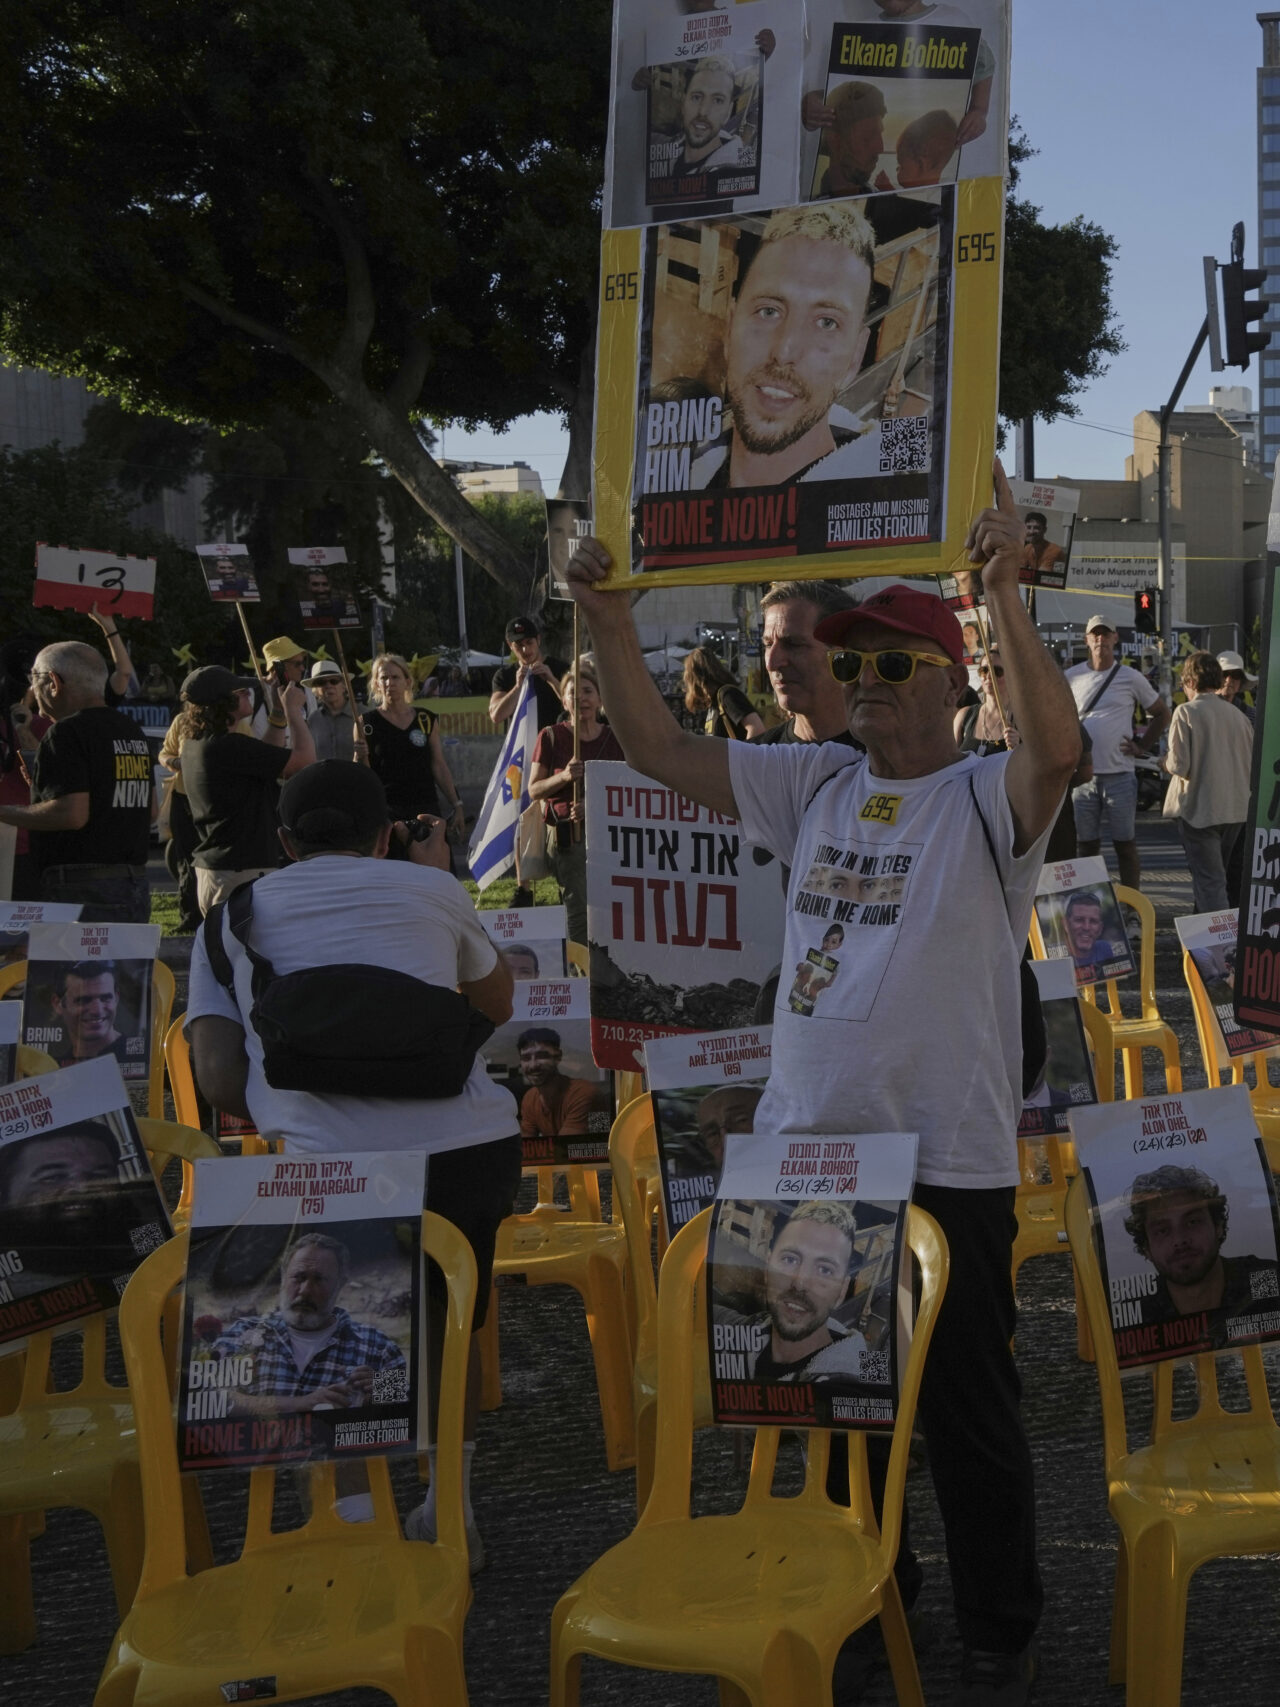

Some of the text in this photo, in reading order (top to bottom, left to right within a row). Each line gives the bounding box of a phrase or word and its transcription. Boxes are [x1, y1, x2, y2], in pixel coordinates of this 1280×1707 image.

[683, 31, 707, 43] ELKANA
[840, 35, 968, 69] Elkana Bohbot
[650, 143, 680, 160] BRING
[650, 161, 667, 178] HIM
[957, 232, 996, 263] 695
[604, 272, 638, 301] 695
[648, 396, 723, 447] BRING
[643, 447, 692, 494] HIM
[643, 486, 798, 547] HOME NOW!
[827, 498, 929, 519] HOSTAGES AND MISSING
[827, 514, 929, 543] FAMILIES FORUM
[1071, 567, 1158, 576] Tel Aviv Museum of
[113, 738, 130, 755] ALL
[112, 780, 150, 808] NOW
[605, 785, 700, 823] שוכחים
[860, 795, 898, 821] 695
[607, 825, 740, 878] את איתי
[814, 844, 912, 876] LOOK IN MY EYES
[611, 875, 743, 952] בעזה
[795, 890, 902, 926] BRING ME HOME
[508, 920, 524, 930] CHEN
[80, 937, 98, 946] DROR
[549, 984, 571, 995] אריאל
[527, 995, 572, 1007] ARIEL CUNIO
[529, 1006, 551, 1017] (27)
[26, 1027, 63, 1042] BRING
[739, 1033, 760, 1048] אריה
[1226, 1030, 1254, 1050] HOME
[689, 1045, 772, 1068] ARIE ZALMANOWICZ
[723, 1063, 742, 1077] (85)
[15, 1084, 42, 1105] איתן
[22, 1096, 53, 1117] HORN
[1141, 1100, 1184, 1120] אלון אהל
[0, 1119, 30, 1140] (38)
[1141, 1116, 1191, 1136] ALON OHEL
[788, 1142, 856, 1160] אלקנה בוחבוט
[1133, 1136, 1160, 1154] (24)
[274, 1160, 353, 1180] אליהו מרגלית
[780, 1159, 860, 1176] ELKANA BOHBOT
[257, 1177, 368, 1198] ELIYAHU MARGALIT
[668, 1175, 715, 1202] BRING
[775, 1178, 804, 1195] (36)
[301, 1197, 325, 1216] (75)
[1109, 1272, 1159, 1302] BRING
[0, 1299, 42, 1331] OME
[44, 1276, 98, 1316] NOW!
[1112, 1299, 1143, 1329] HIM
[1226, 1315, 1251, 1326] HOSTAGES
[1251, 1313, 1262, 1323] AND
[713, 1323, 764, 1352] BRING
[1115, 1312, 1209, 1357] HOME NOW!
[1227, 1322, 1260, 1339] FAMILIES
[188, 1356, 254, 1390] BRING
[714, 1352, 746, 1381] HIM
[186, 1390, 229, 1421] HIM
[716, 1383, 816, 1413] HOME NOW!
[832, 1405, 895, 1421] FAMILIES FORUM
[185, 1413, 313, 1456] HOME NOW!
[335, 1417, 409, 1434] HOSTAGES AND MISSING
[334, 1427, 409, 1448] FAMILIES FORUM
